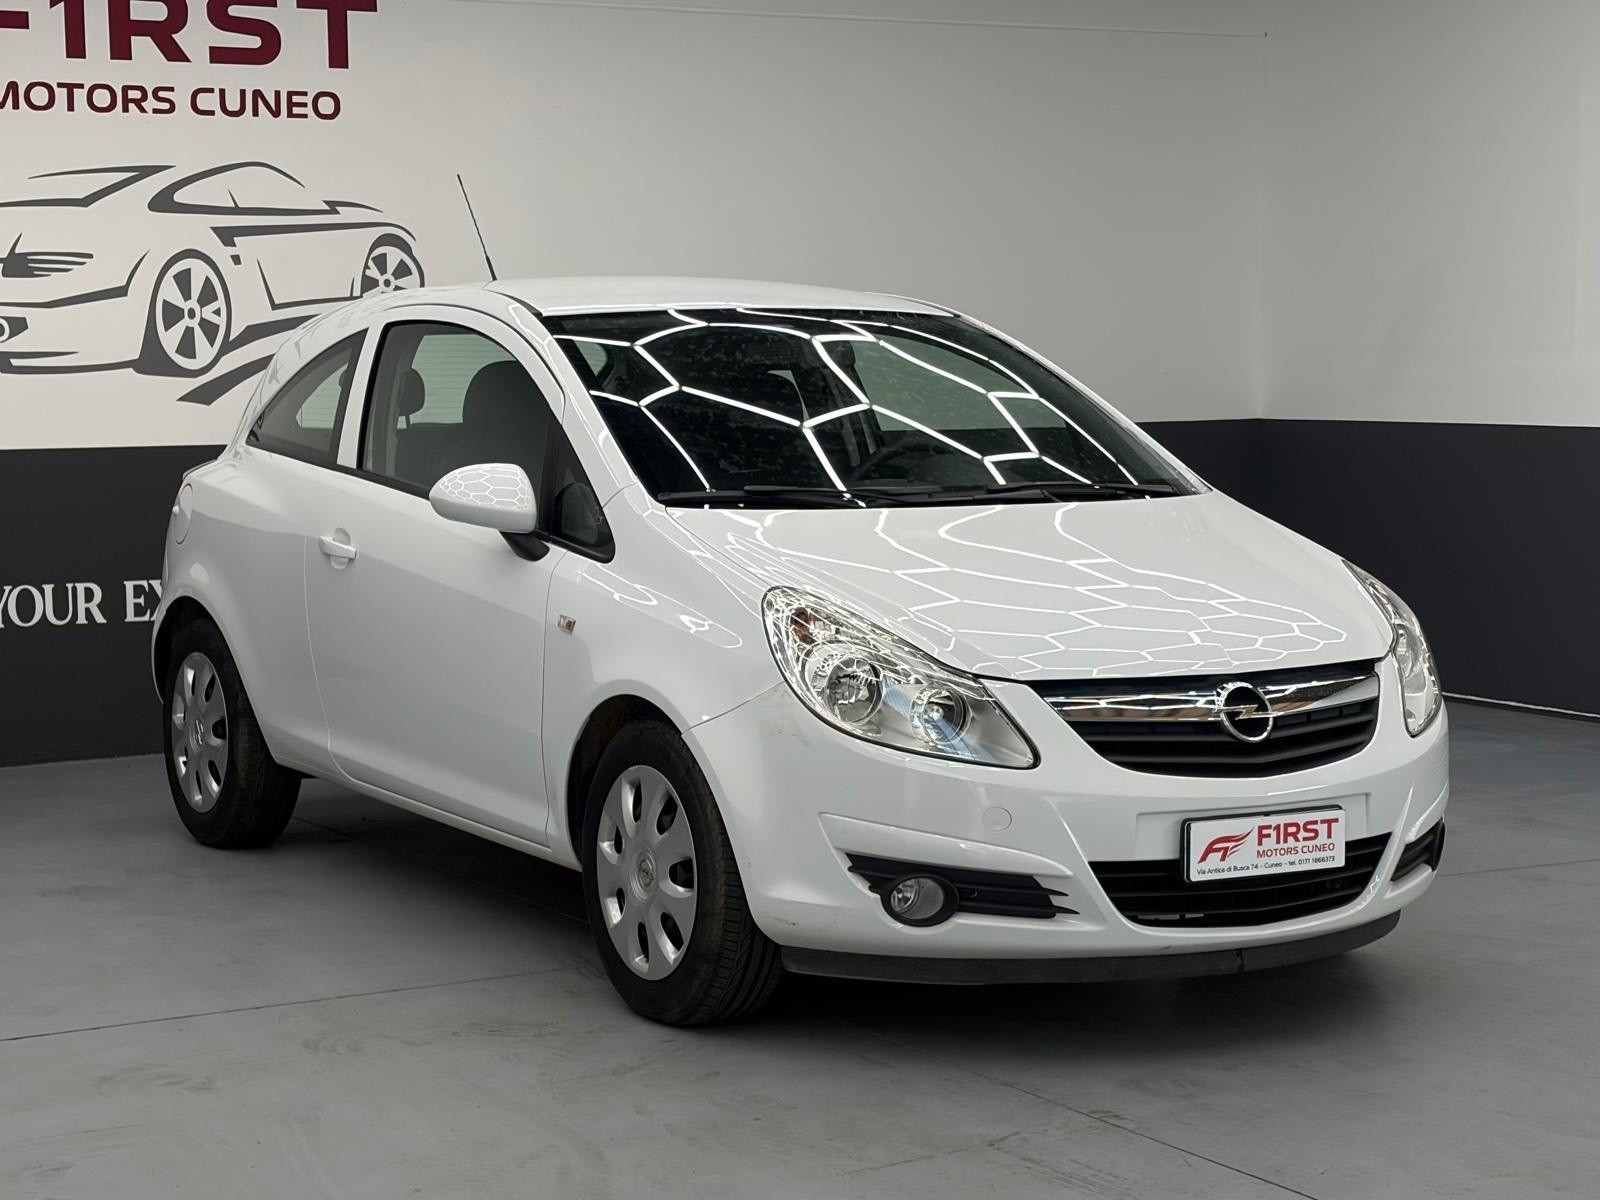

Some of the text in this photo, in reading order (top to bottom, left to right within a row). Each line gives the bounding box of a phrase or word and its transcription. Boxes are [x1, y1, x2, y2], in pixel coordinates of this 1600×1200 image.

[0, 0, 378, 69] 1RST
[190, 87, 341, 120] CUNEO
[1257, 818, 1340, 847] F1RST
[1256, 842, 1336, 859] MOTORS CUNEO
[1226, 865, 1232, 873] di
